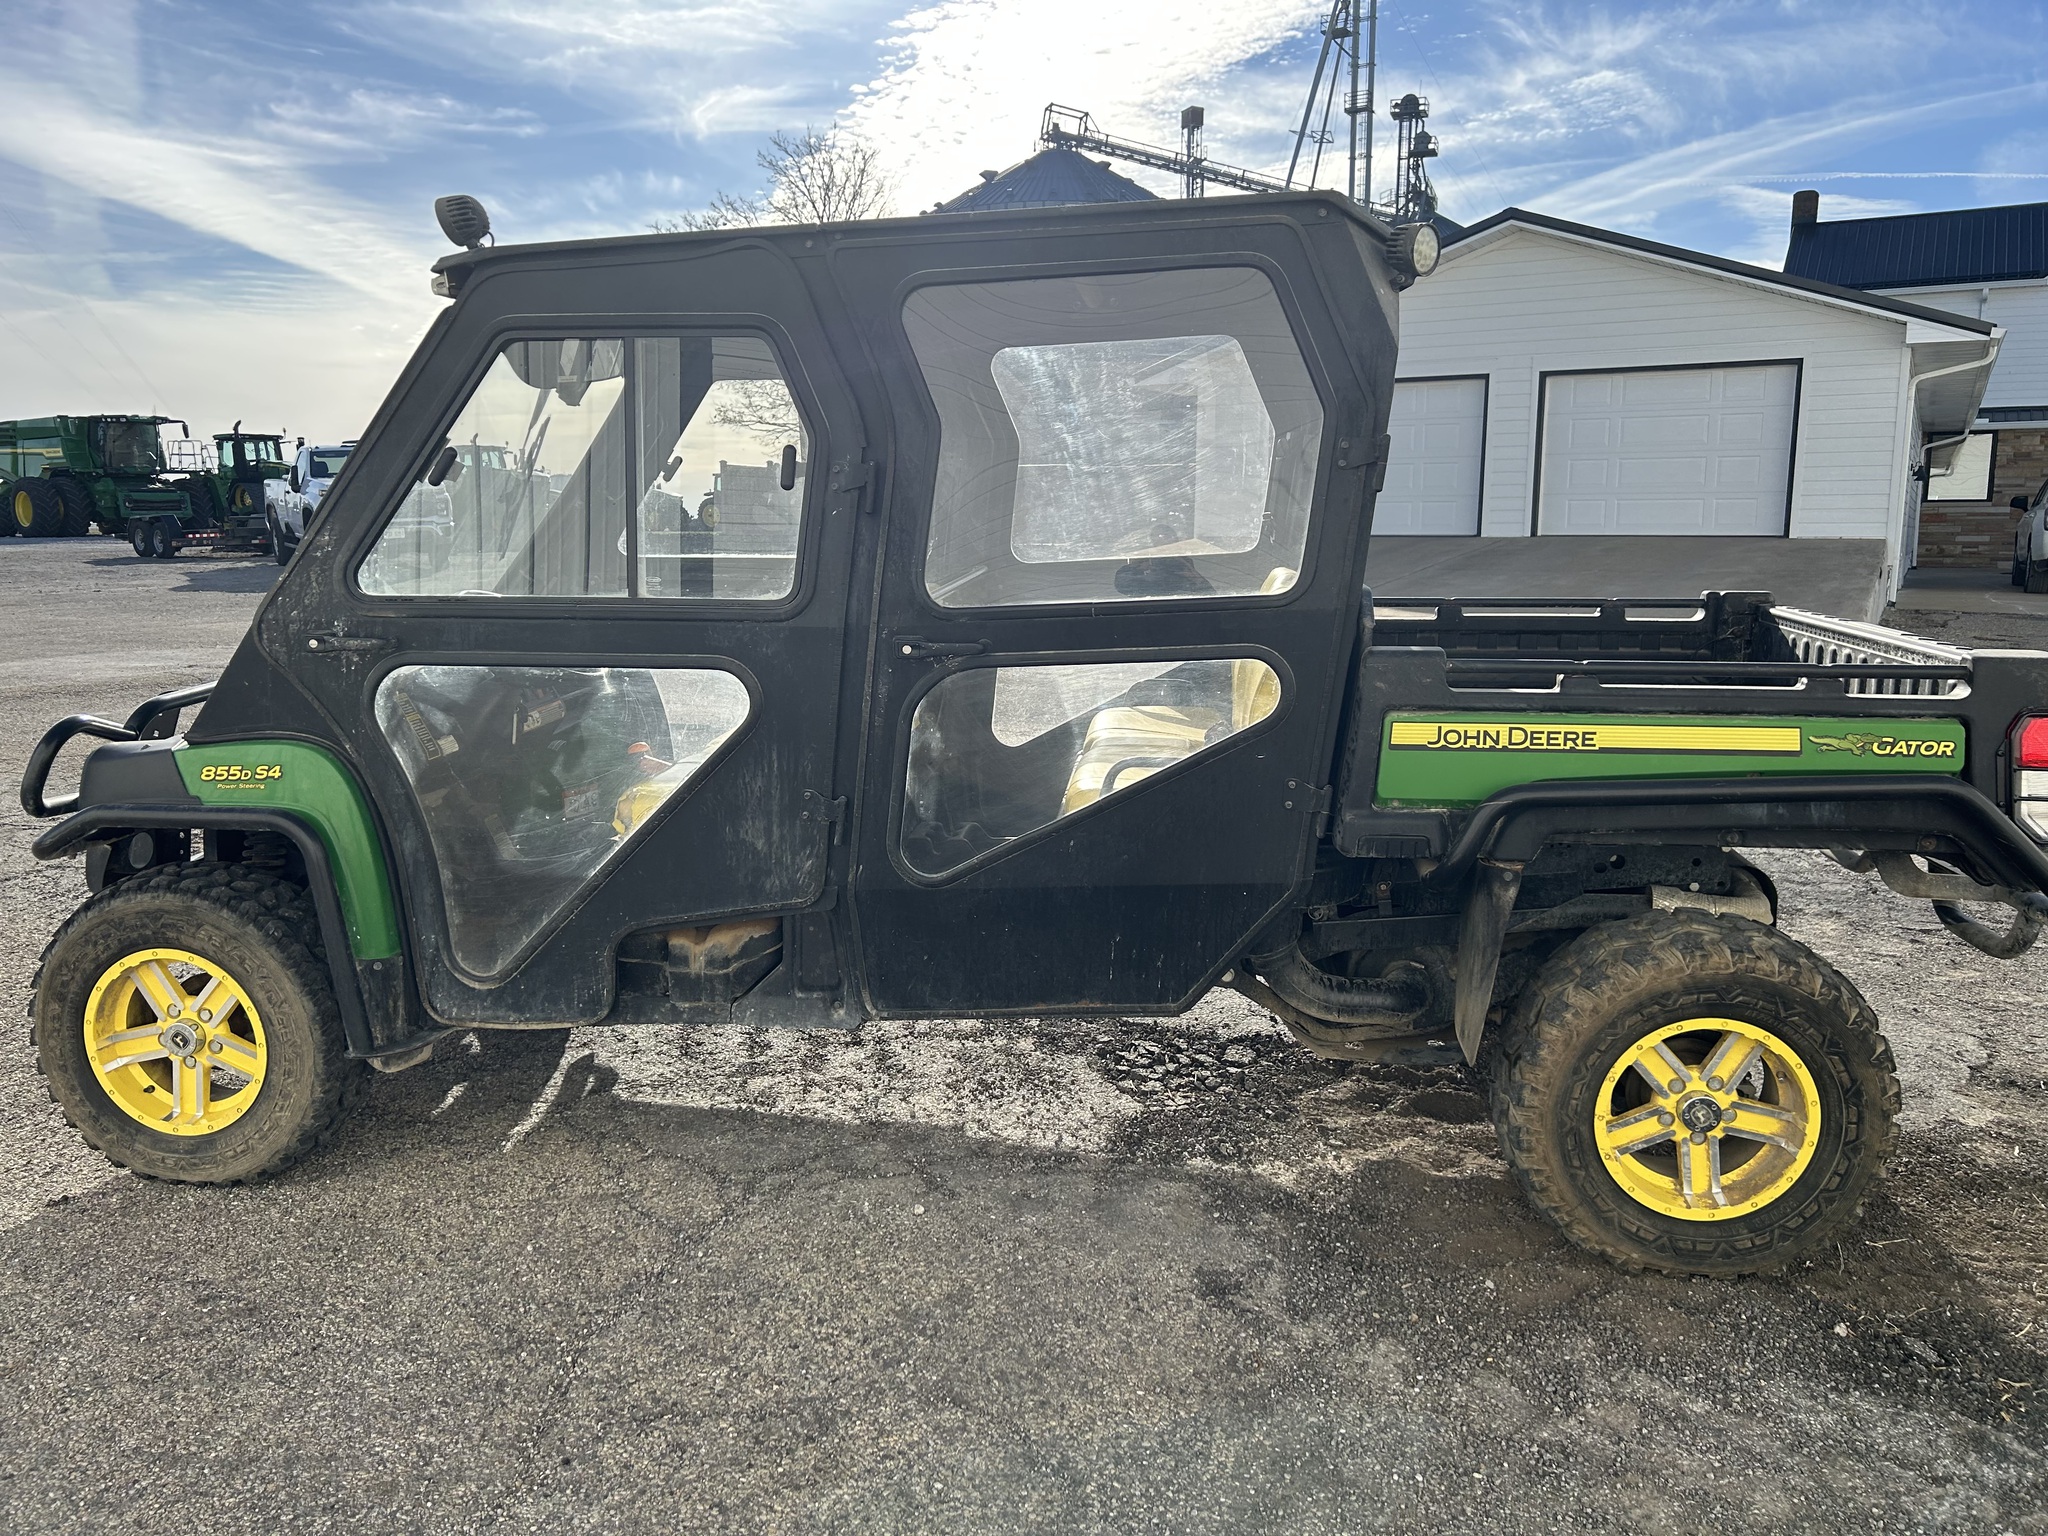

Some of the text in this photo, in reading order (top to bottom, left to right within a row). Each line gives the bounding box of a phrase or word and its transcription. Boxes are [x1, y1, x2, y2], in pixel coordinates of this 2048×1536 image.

[1427, 725, 1597, 749] JOHN DEERE
[1872, 737, 1956, 757] GATOR
[200, 764, 282, 781] 855D S4
